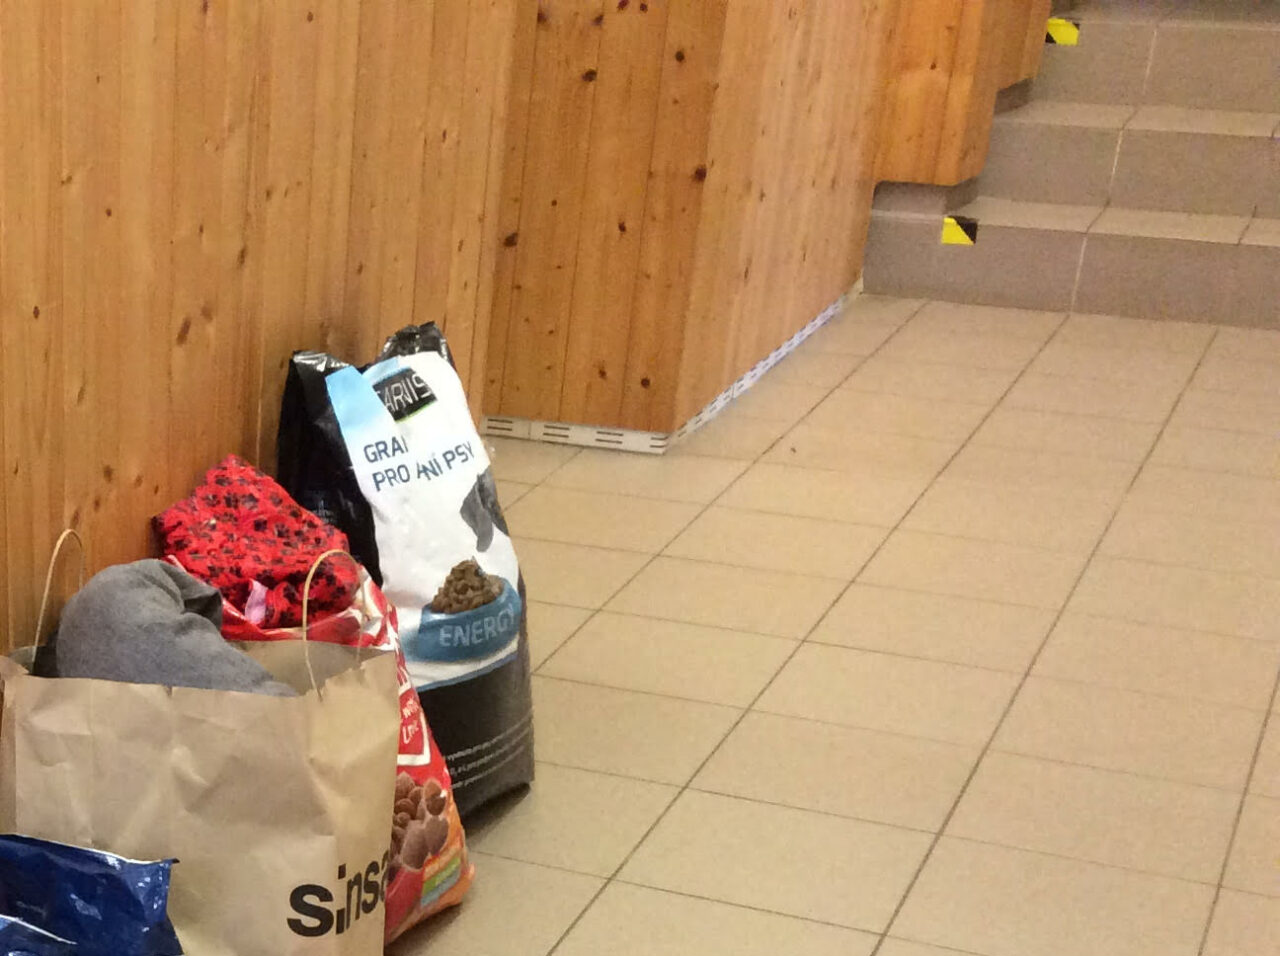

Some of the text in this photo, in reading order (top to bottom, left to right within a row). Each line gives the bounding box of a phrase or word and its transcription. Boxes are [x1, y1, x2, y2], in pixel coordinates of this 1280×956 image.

[376, 374, 434, 413] ARVIS
[372, 464, 410, 492] PRO
[442, 440, 475, 470] PSY
